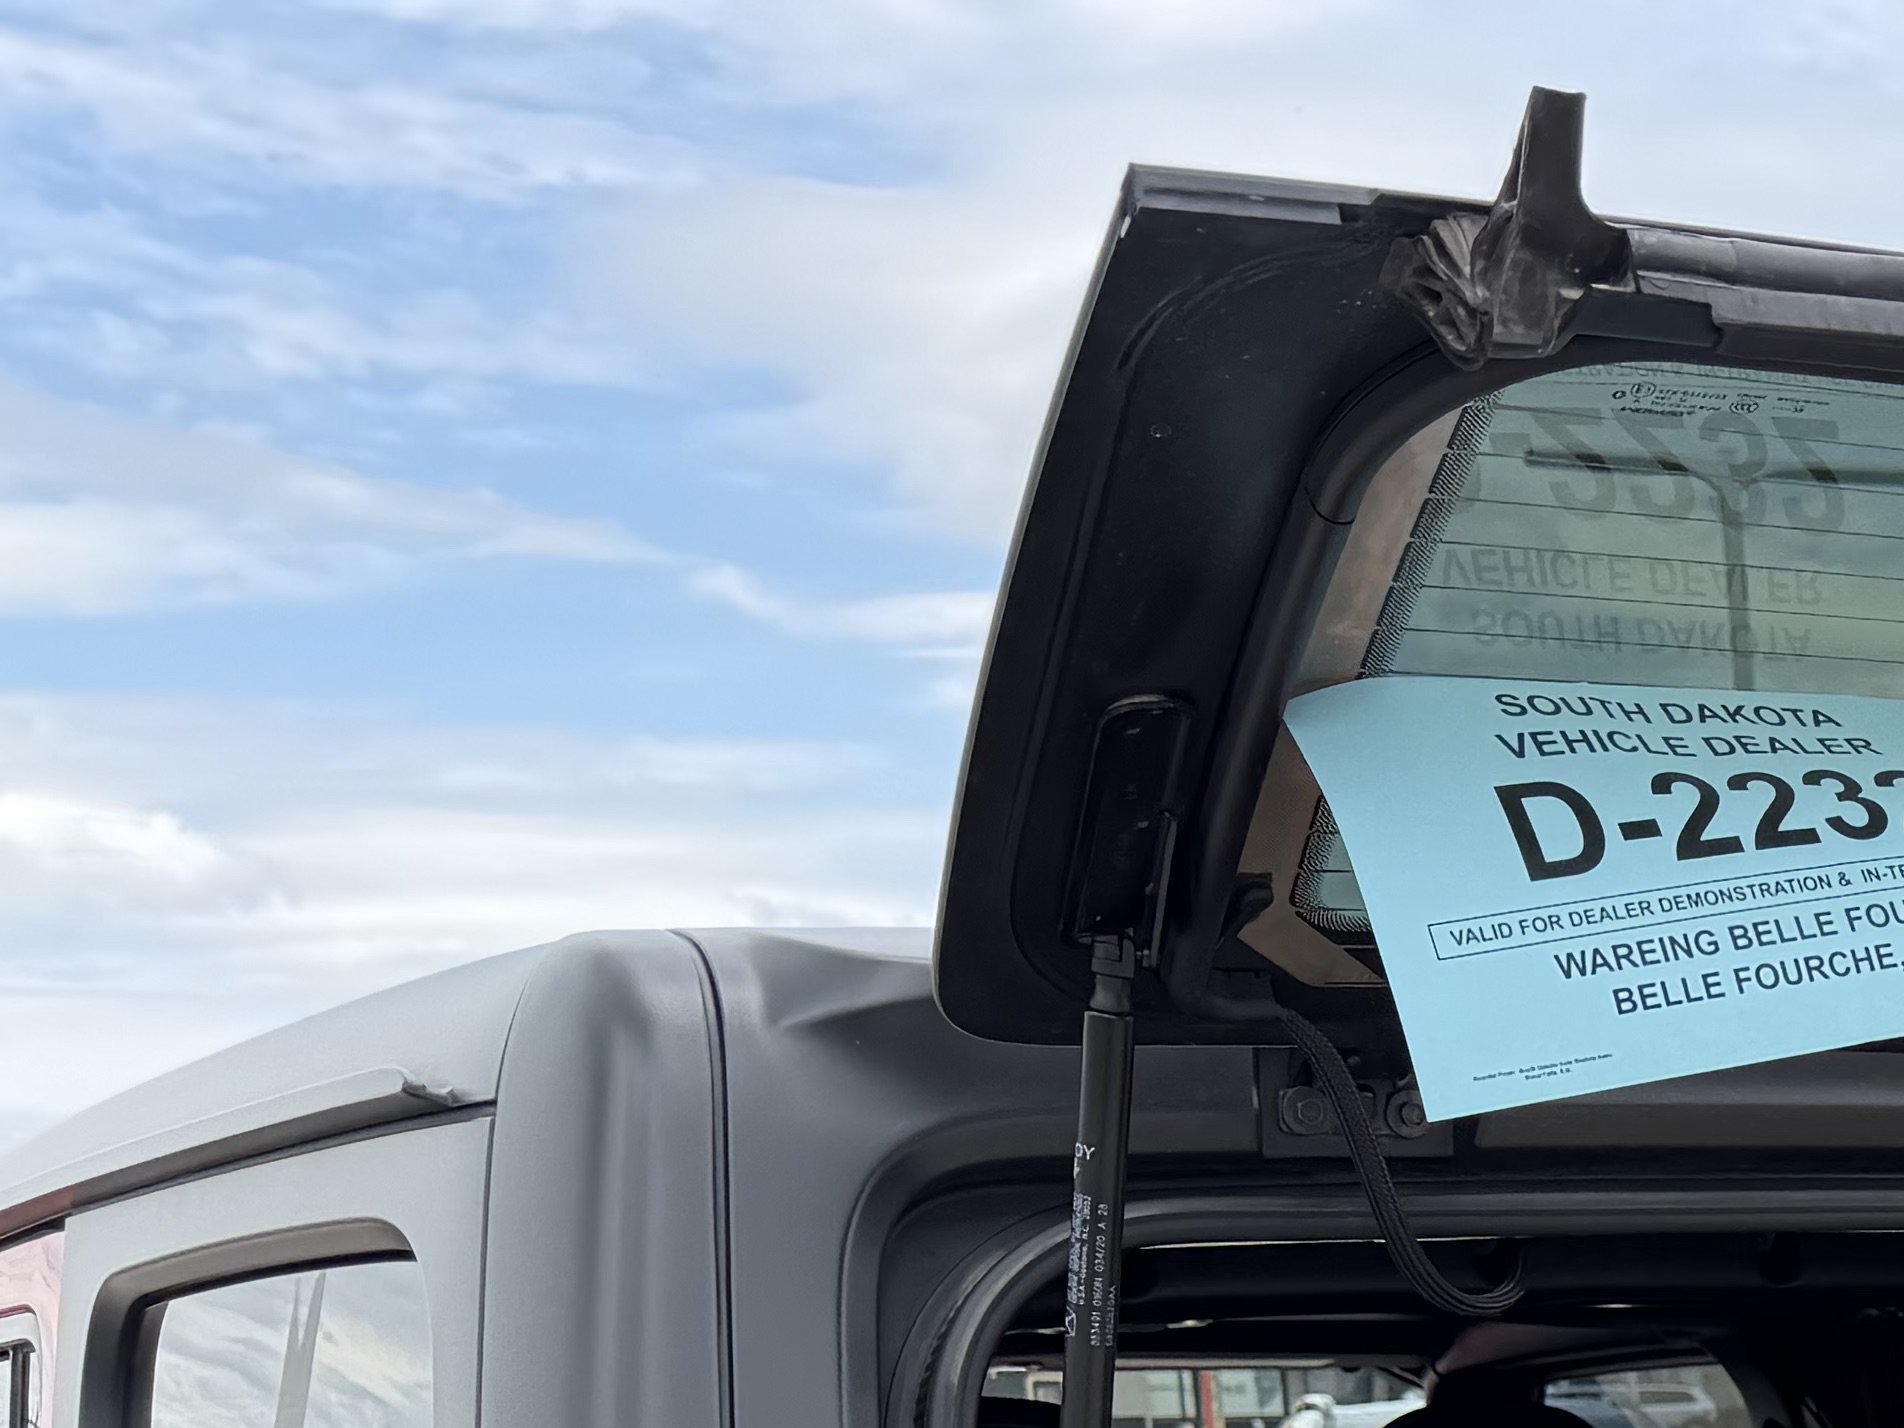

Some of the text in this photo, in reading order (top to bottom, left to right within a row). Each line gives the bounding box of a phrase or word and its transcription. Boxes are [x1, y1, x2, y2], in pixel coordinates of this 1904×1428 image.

[1494, 694, 1843, 728] SOUTH DAKOTA
[1494, 730, 1883, 759] VEHICLE DEALER
[1449, 921, 1513, 947] VALID
[1518, 914, 1565, 937] FOR
[1568, 900, 1654, 928] DEALER
[1657, 872, 1832, 914] DEMONSTRATION
[1838, 871, 1852, 886] &
[1553, 929, 1721, 980] WAREING
[1727, 911, 1839, 952] BELLE
[1612, 971, 1726, 1016] BELLE
